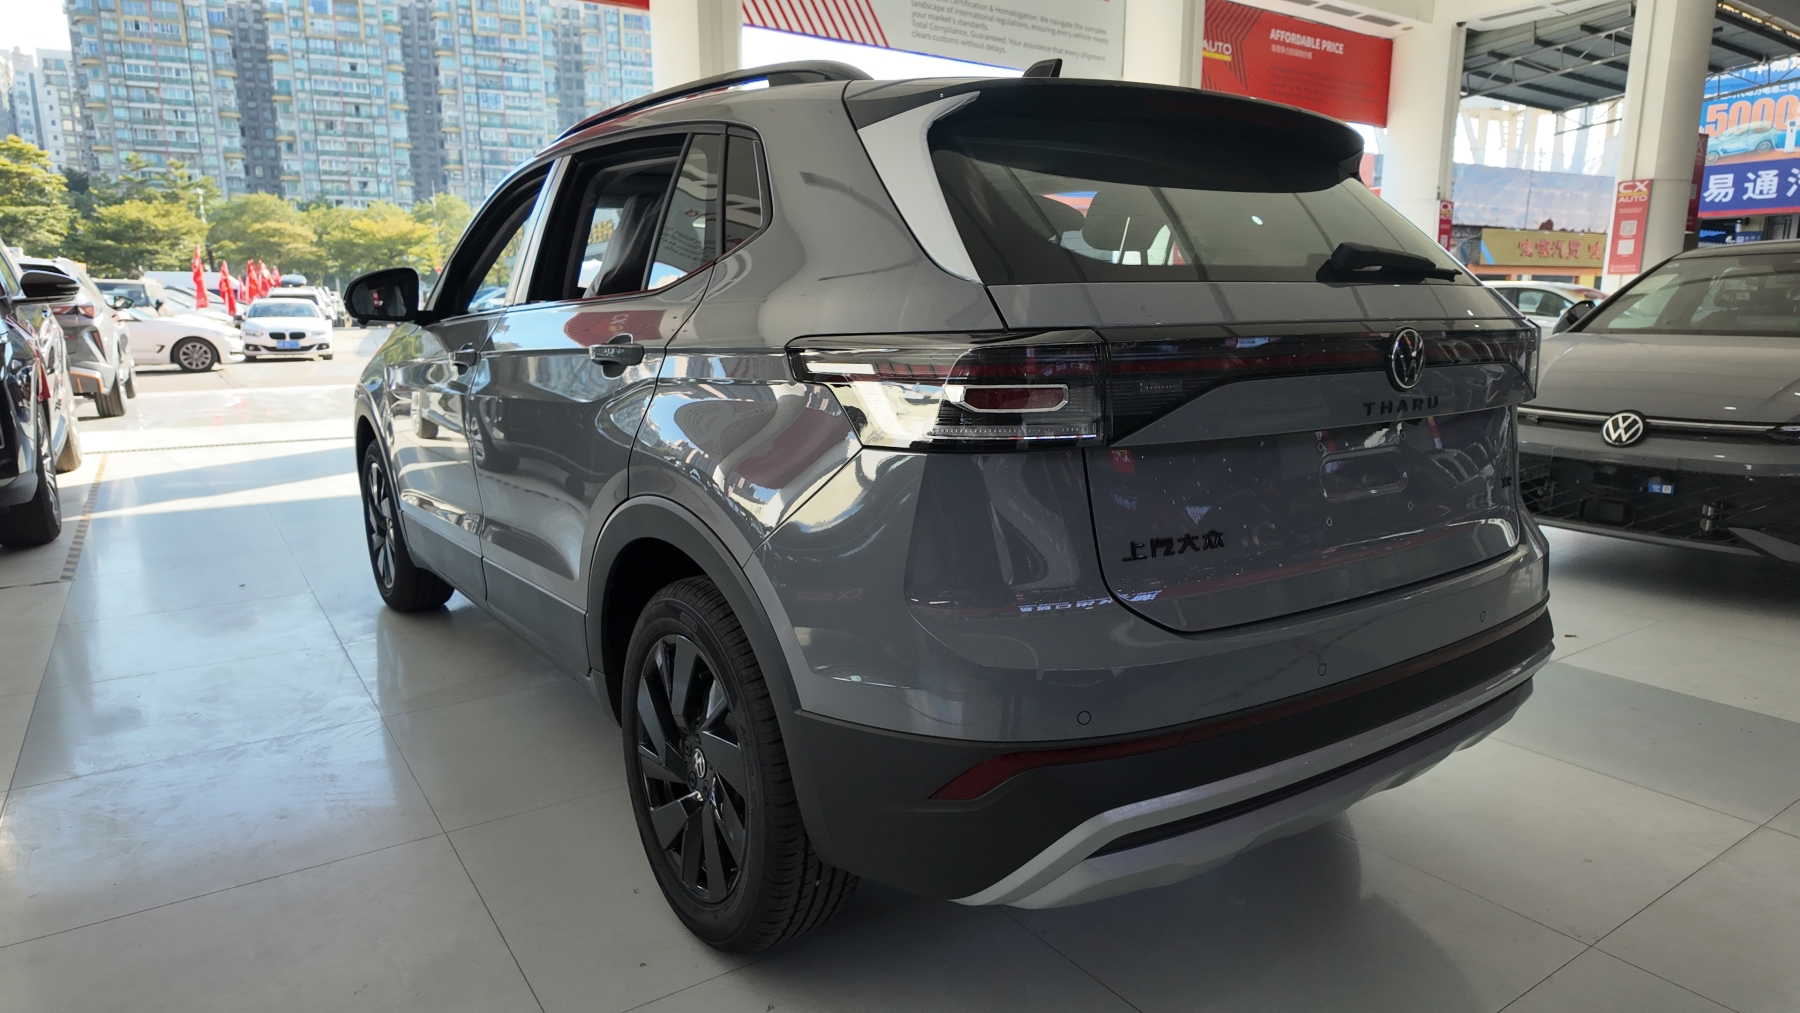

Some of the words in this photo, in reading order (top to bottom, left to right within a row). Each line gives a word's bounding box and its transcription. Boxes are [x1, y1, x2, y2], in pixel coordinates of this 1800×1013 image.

[911, 11, 927, 19] your
[928, 13, 956, 25] market's
[957, 19, 989, 31] standards.
[954, 8, 994, 22] international
[1031, 24, 1056, 36] ensuring
[1057, 29, 1072, 39] every
[1073, 32, 1092, 41] vehicle
[1093, 36, 1109, 45] meets
[1050, 18, 1073, 29] navigate
[1074, 22, 1083, 30] the
[1084, 25, 1107, 36] complex
[911, 30, 931, 40] clears
[932, 34, 960, 45] customs
[960, 40, 985, 50] without
[985, 43, 1007, 54] delays.
[912, 19, 929, 29] Total
[929, 22, 969, 37] Compliance,
[1023, 41, 1052, 52] assurance
[1052, 46, 1064, 54] that
[1064, 49, 1079, 58] every
[1080, 52, 1106, 62] shipment
[1202, 39, 1232, 55] AUTO
[1270, 28, 1321, 50] AFFORDABLE
[1321, 40, 1344, 55] PRICE
[1618, 180, 1649, 194] CX
[1618, 194, 1648, 204] AUTO
[1364, 395, 1440, 417] THARU
[1122, 529, 1226, 563] 上汽大众
